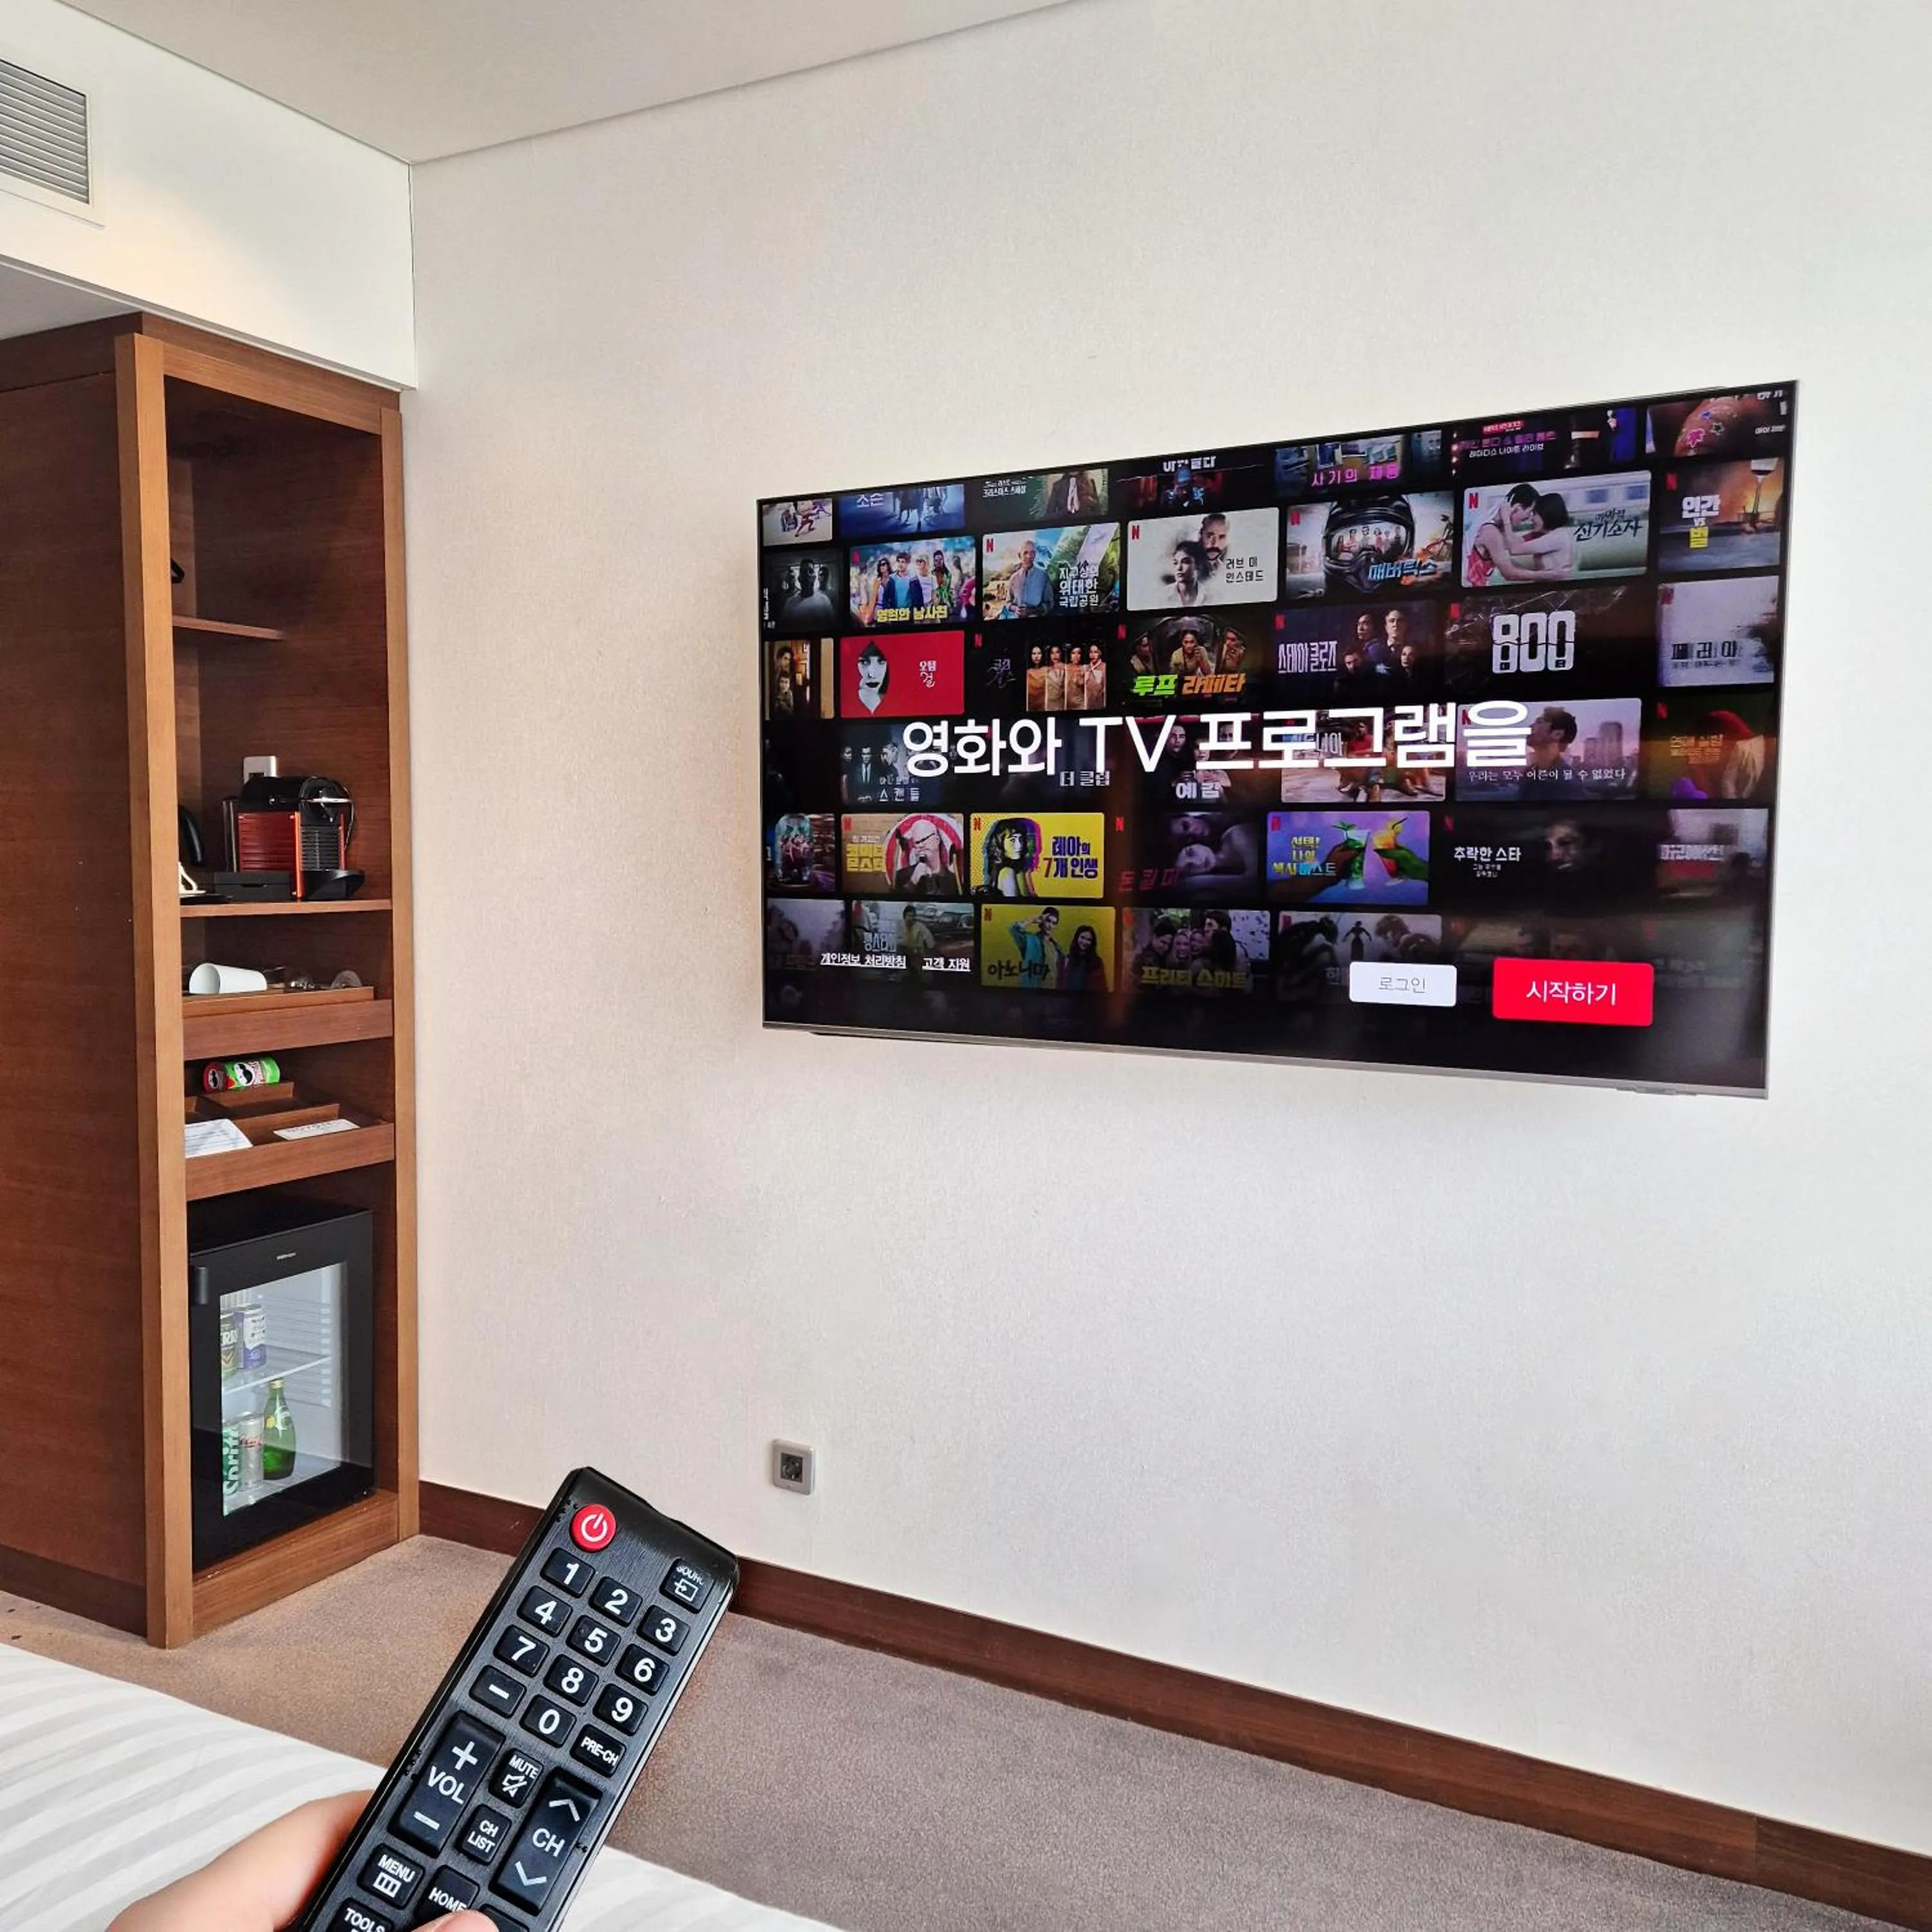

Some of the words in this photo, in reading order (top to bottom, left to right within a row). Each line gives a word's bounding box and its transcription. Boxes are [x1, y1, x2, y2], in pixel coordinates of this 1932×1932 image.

[1226, 558, 1244, 570] 러브
[1059, 578, 1099, 595] 위대한
[1059, 594, 1098, 607] 국립공원
[1133, 674, 1178, 696] 루프
[903, 717, 1062, 777] 영화와
[1079, 715, 1176, 773] TV
[1195, 700, 1531, 770] 프로그램을
[1060, 771, 1075, 786] 더
[1577, 770, 1588, 781] 수
[878, 787, 921, 802] 스캔들
[1052, 836, 1090, 857] 레아의
[1454, 847, 1493, 862] 추락한
[1495, 847, 1521, 862] 스타
[1070, 857, 1098, 879] 인생
[820, 952, 860, 966] 개인정보
[864, 954, 906, 969] 처리방침
[922, 958, 944, 971] 고객
[947, 958, 971, 971] 지원
[1379, 977, 1426, 994] 로그인
[1526, 980, 1616, 1006] 시작하기
[564, 1562, 580, 1585] 1
[535, 1600, 557, 1625] 4
[604, 1589, 628, 1615] 2
[584, 1627, 608, 1653] 5
[655, 1618, 676, 1643] 3
[511, 1636, 536, 1662] 7
[561, 1667, 584, 1694] 8
[634, 1658, 656, 1683] 6
[538, 1709, 560, 1734] 0
[611, 1697, 634, 1723] 9
[581, 1737, 619, 1766] PRE-CH
[508, 1754, 539, 1779] MUTE
[429, 1765, 465, 1805] VOL
[479, 1819, 500, 1838] CH
[467, 1833, 495, 1853] LIST
[531, 1828, 565, 1858] CH
[377, 1853, 416, 1883] MENU
[428, 1887, 468, 1913] HOME
